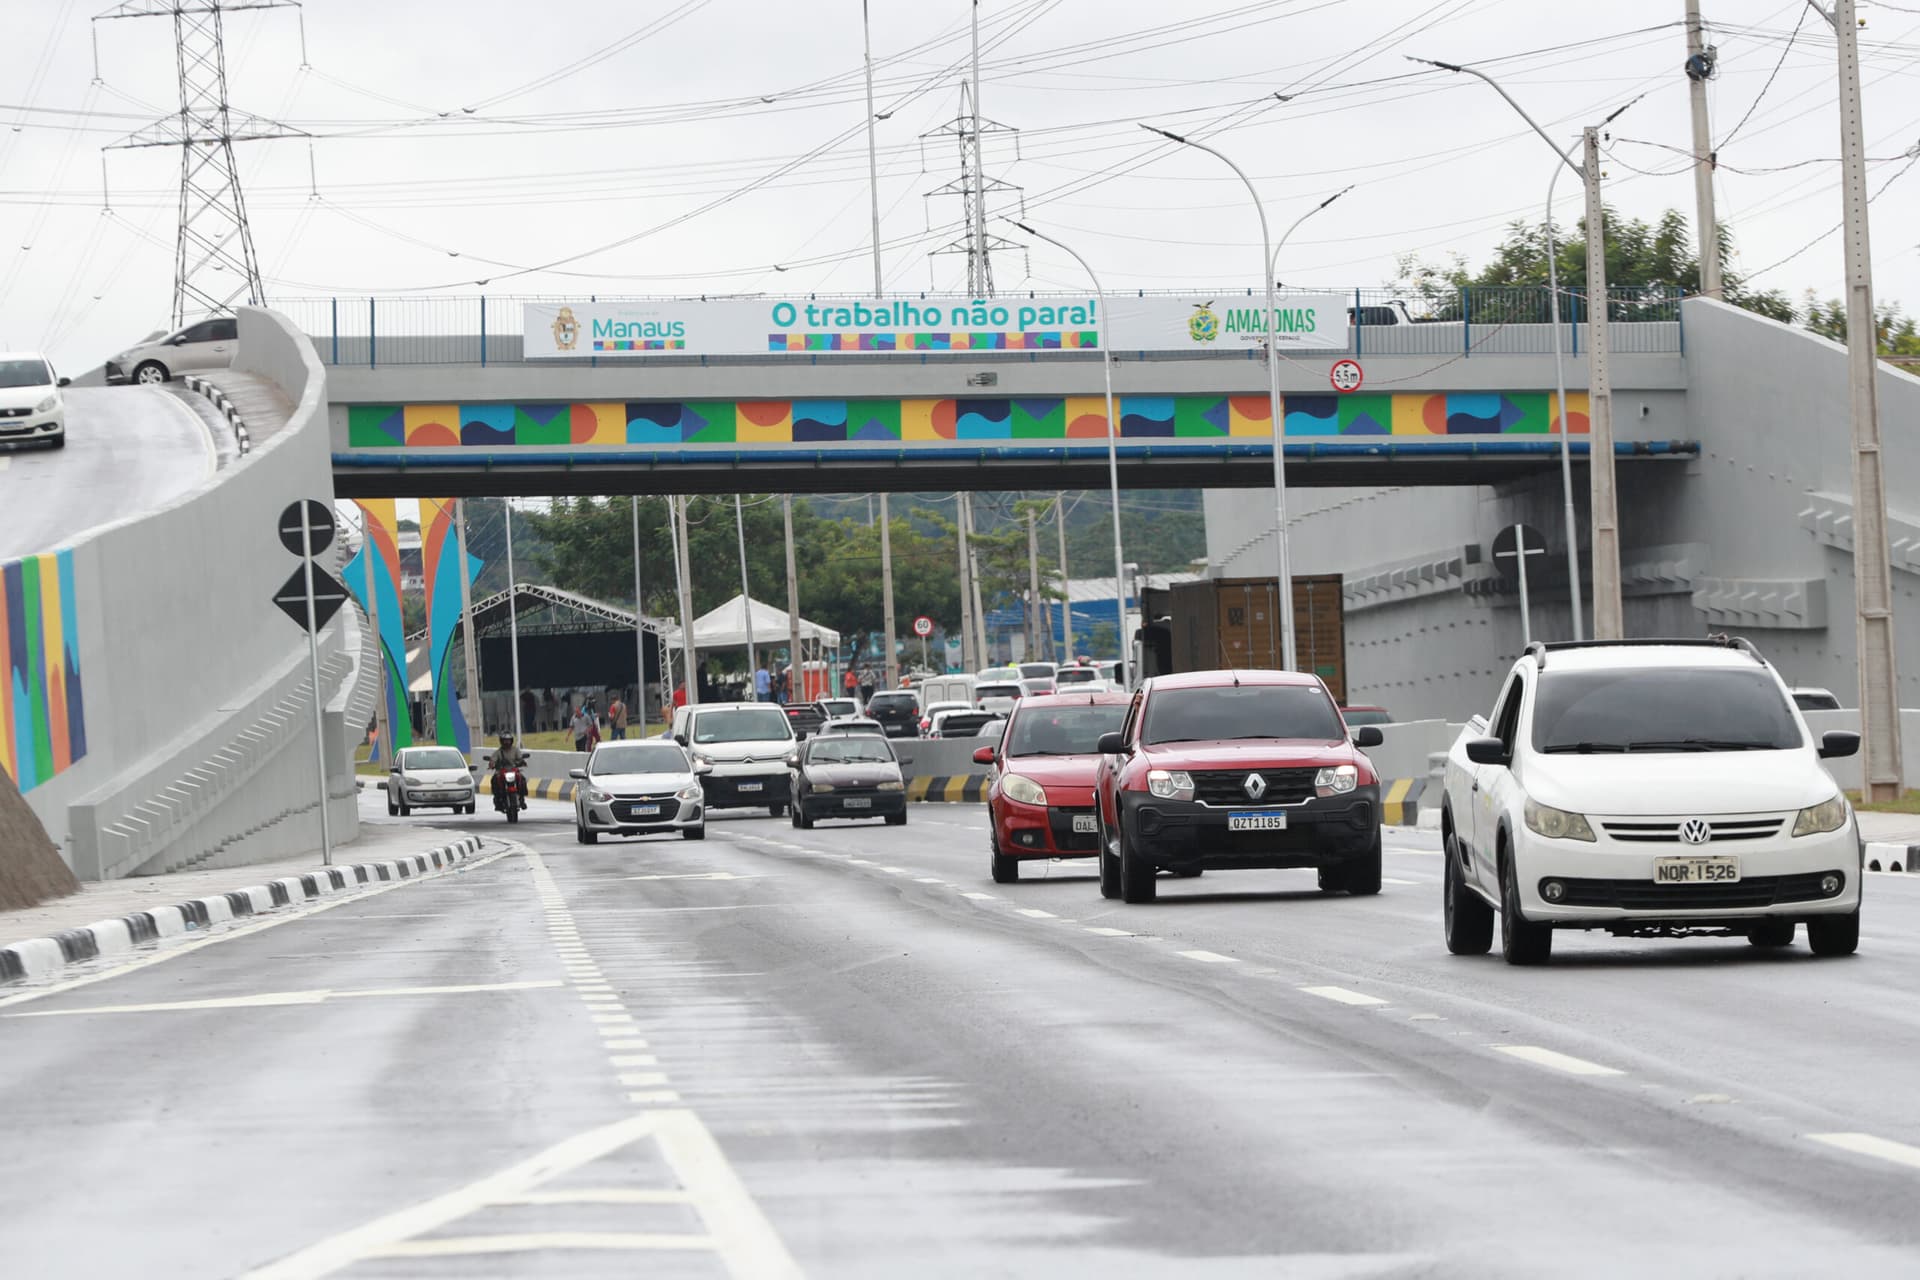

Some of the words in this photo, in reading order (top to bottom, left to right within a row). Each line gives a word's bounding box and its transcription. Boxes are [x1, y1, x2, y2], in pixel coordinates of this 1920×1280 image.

[771, 302, 797, 328] O
[804, 301, 942, 327] trabalho
[951, 299, 1009, 326] não
[1018, 299, 1096, 332] para!
[1225, 308, 1316, 333] AMAZONAS
[592, 318, 685, 338] Manaus
[917, 620, 929, 629] 60
